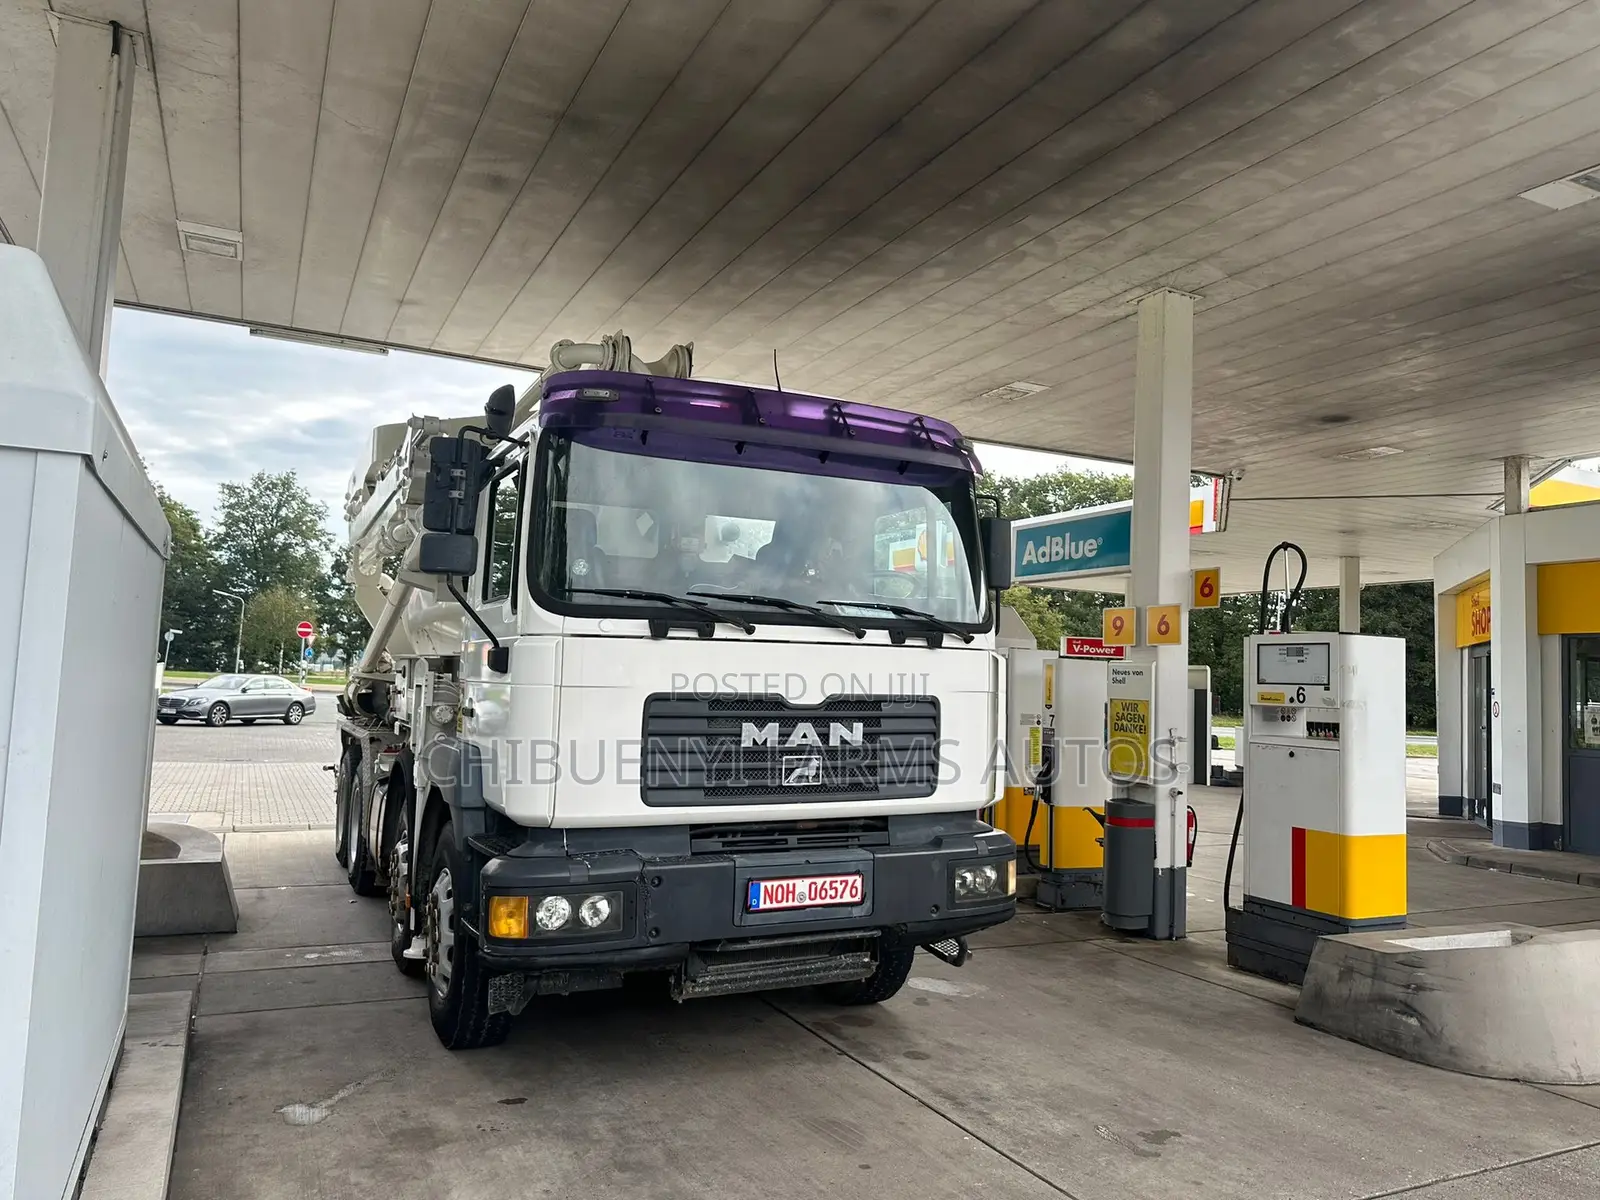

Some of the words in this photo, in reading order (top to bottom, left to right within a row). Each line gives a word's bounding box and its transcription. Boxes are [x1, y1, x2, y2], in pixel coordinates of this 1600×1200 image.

[1199, 576, 1214, 598] 6
[1112, 616, 1125, 637] 9
[1156, 614, 1170, 636] 6
[1072, 644, 1116, 654] V-Power
[1112, 668, 1131, 677] Neues
[1111, 677, 1126, 685] Shell
[1296, 686, 1306, 704] 6
[1120, 701, 1140, 713] WIR
[1048, 714, 1055, 727] 7
[1115, 711, 1145, 724] SAGEN
[740, 722, 864, 748] MAN
[1113, 721, 1147, 735] DANKE!
[763, 882, 796, 905] NOH
[808, 878, 859, 902] 06576
